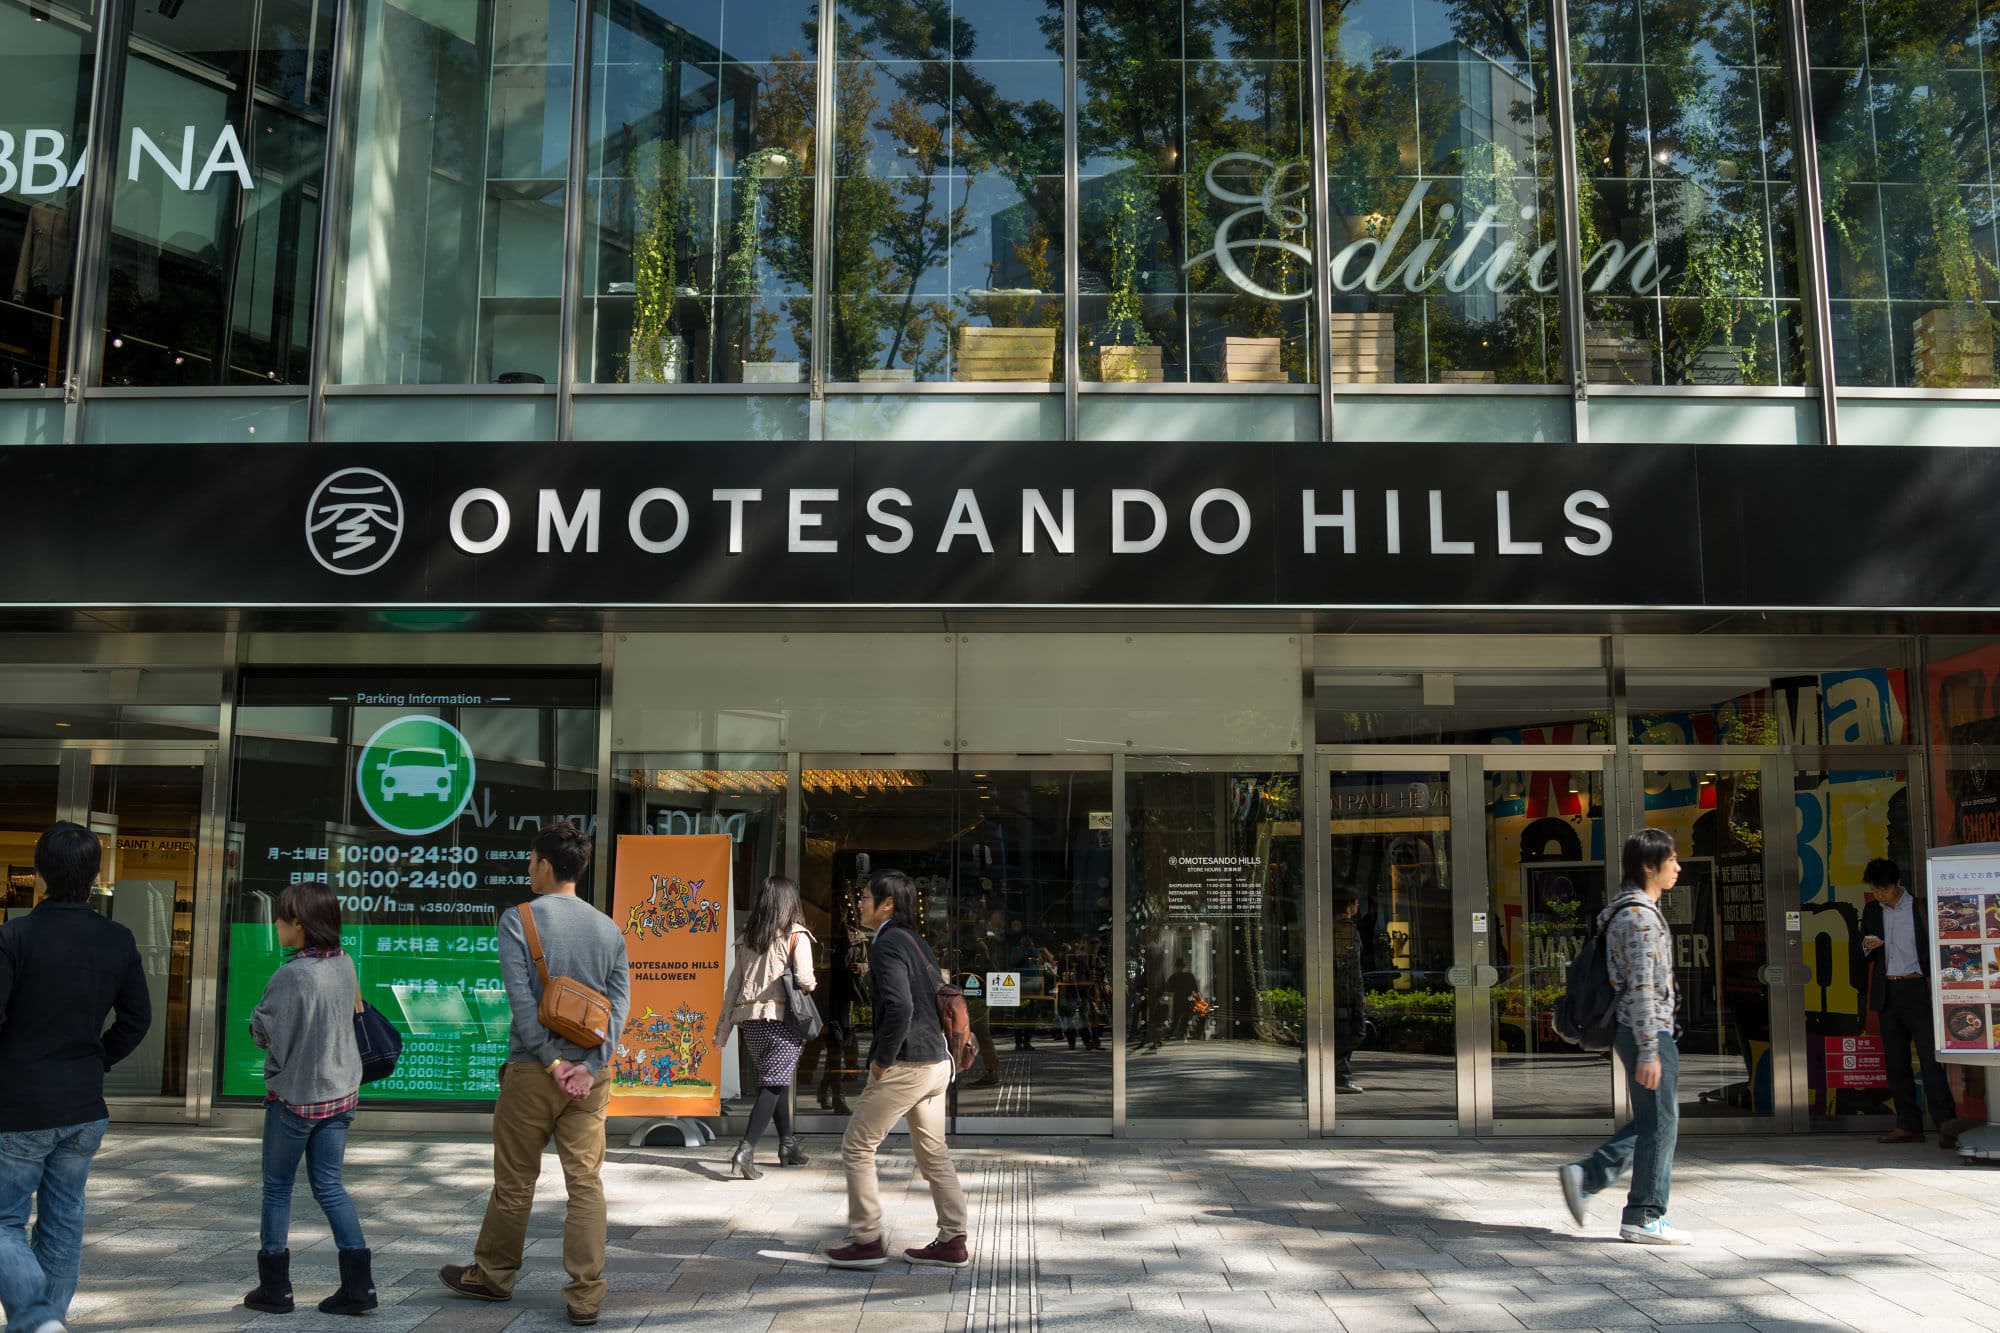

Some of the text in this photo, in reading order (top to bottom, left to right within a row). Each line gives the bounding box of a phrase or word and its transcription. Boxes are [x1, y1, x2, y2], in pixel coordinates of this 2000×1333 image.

[1182, 151, 1672, 300] Edition
[448, 487, 1614, 556] OMOTESANDO HILLS
[356, 692, 481, 706] Parking Information
[116, 839, 150, 849] SAINT
[336, 845, 478, 864] 10:00-24:30
[1178, 856, 1262, 865] OMOTESANDO HILLS
[335, 869, 478, 889] 10:00-24:00
[647, 874, 705, 908] HAPPY
[623, 899, 722, 941] HALLOWEEN
[376, 936, 440, 953] 最大料金
[691, 961, 720, 970] HILLS
[635, 972, 697, 981] HALLOWEEN
